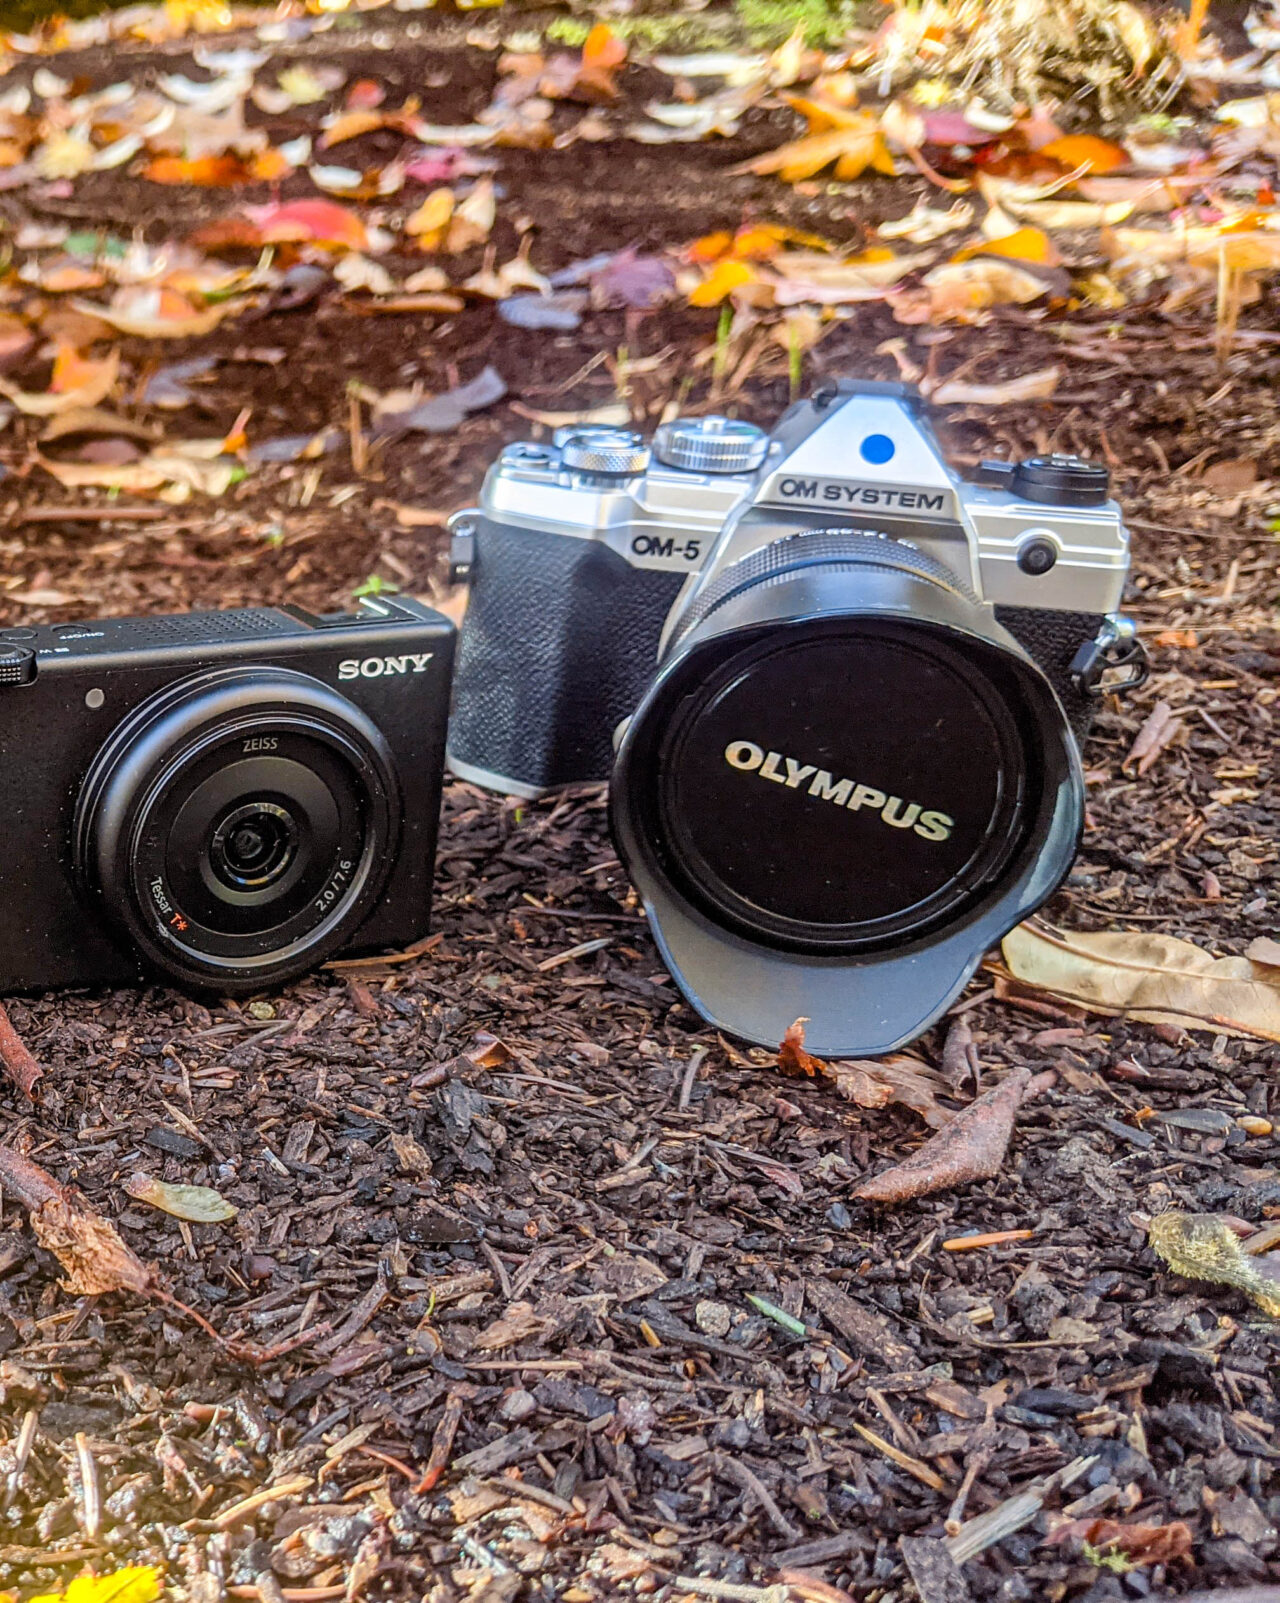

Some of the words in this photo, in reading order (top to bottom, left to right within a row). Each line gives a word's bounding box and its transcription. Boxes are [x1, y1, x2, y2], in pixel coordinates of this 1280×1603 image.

[780, 478, 818, 499] OM
[823, 485, 945, 511] SYSTEM
[630, 534, 702, 561] OM-5
[337, 652, 434, 680] SONY
[242, 736, 279, 753] ZEISS
[724, 740, 955, 842] OLYMPUS
[150, 876, 173, 914] Tessar
